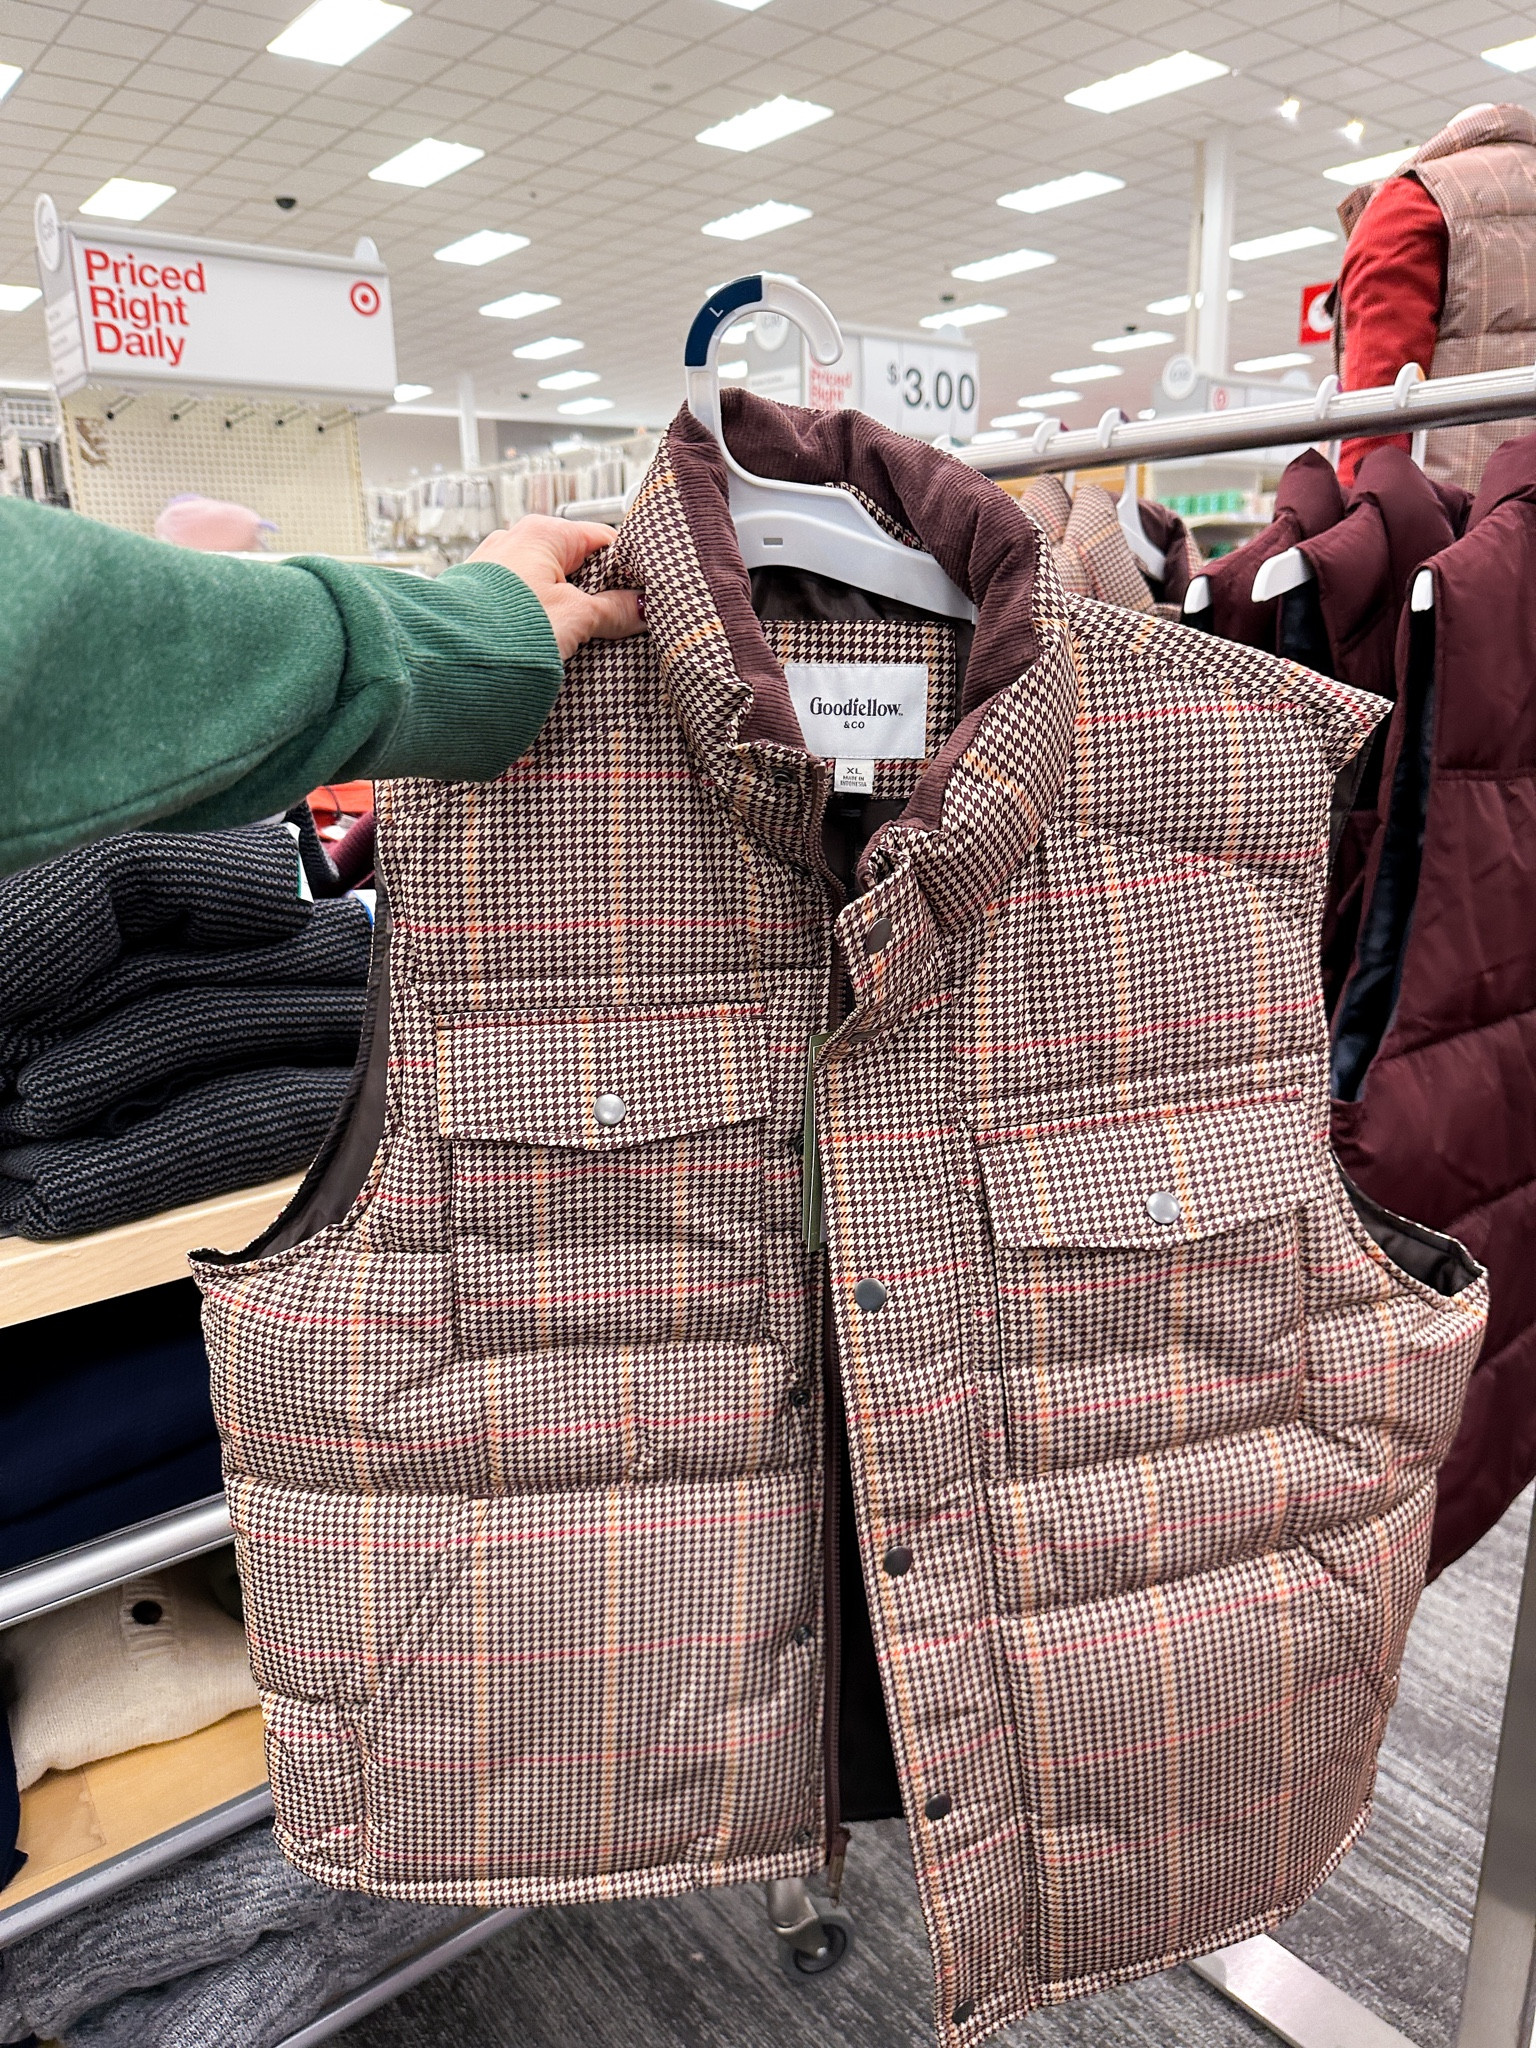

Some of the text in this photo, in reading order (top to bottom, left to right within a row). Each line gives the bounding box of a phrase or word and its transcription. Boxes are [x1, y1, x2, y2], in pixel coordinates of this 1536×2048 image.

[84, 248, 206, 293] Priced
[89, 285, 190, 329] Right
[94, 321, 185, 366] Daily
[887, 361, 977, 413] $3.00
[846, 767, 862, 775] XL
